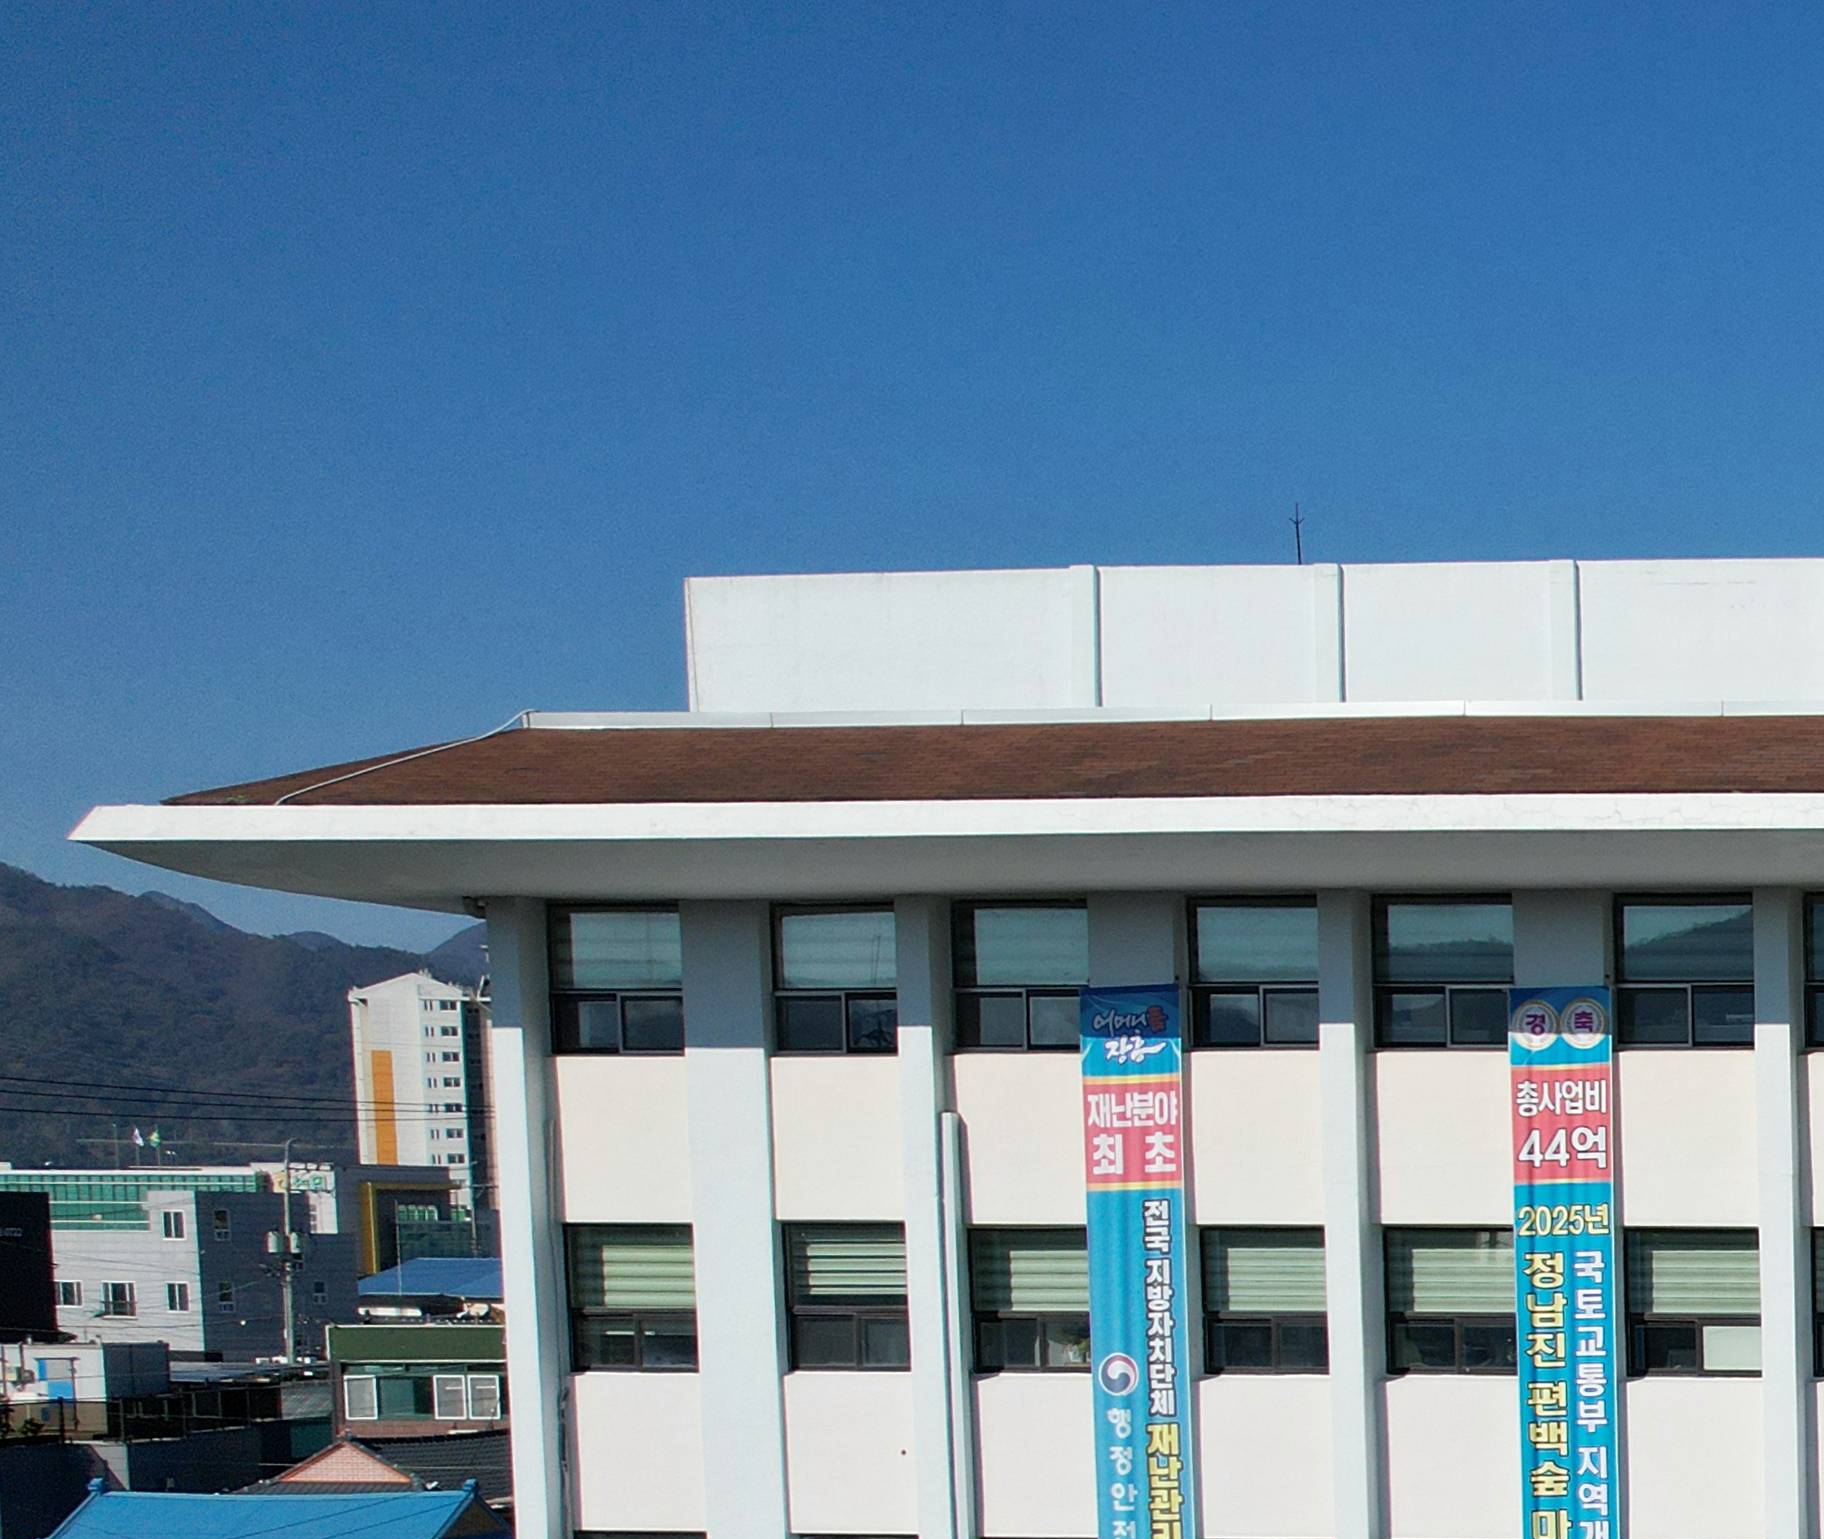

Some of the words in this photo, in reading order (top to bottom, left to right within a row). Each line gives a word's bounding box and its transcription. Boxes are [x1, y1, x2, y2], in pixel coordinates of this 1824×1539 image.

[1087, 1090, 1178, 1129] 재난분야
[1515, 1078, 1608, 1117] 총사업비
[1517, 1125, 1608, 1170] 44억
[1142, 1198, 1171, 1254] 전국
[1516, 1203, 1611, 1238] 2025년
[1522, 1250, 1569, 1370] 정남진
[1145, 1258, 1177, 1418] 지방자치단체
[1573, 1249, 1609, 1432] 국토교통부
